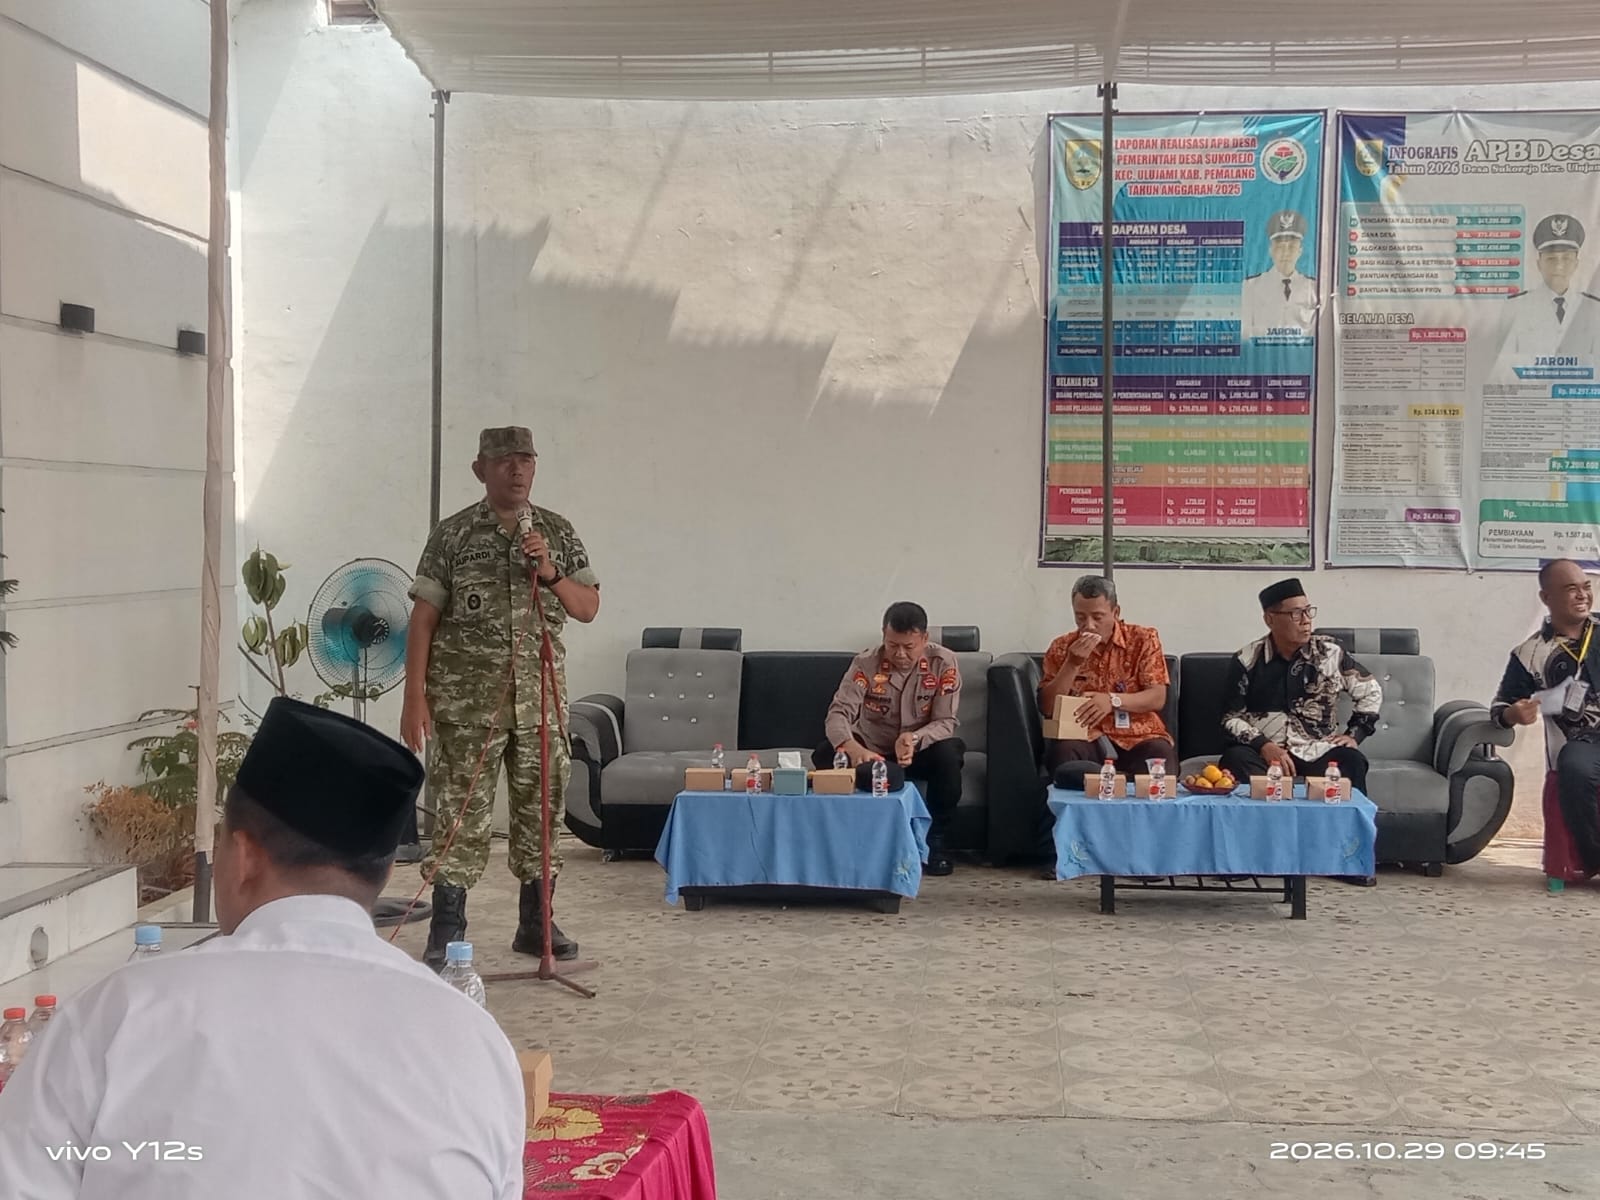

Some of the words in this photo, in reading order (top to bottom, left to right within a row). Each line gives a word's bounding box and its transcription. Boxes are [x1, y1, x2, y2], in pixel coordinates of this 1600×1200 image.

[1114, 138, 1158, 150] LAPORAN
[1160, 138, 1209, 150] REALISASI
[1210, 137, 1230, 149] APB
[1232, 137, 1257, 149] DESA
[1389, 146, 1458, 160] INFOGRAFIS
[1464, 139, 1600, 162] APBDesa
[1116, 153, 1177, 166] PEMERINTAH
[1178, 153, 1203, 165] DESA
[1205, 152, 1254, 165] SUKOREJO
[1114, 169, 1136, 181] KEC.
[1137, 169, 1178, 180] ULUJAMI
[1180, 168, 1203, 180] KAB.
[1204, 168, 1256, 180] PEMALANG
[1386, 161, 1425, 175] Tahun
[1427, 161, 1460, 175] 2026
[1128, 184, 1160, 196] TAHUN
[1161, 184, 1213, 196] ANGGARAN
[1215, 183, 1241, 195] 2025
[1091, 224, 1158, 235] PEDAPATAN
[1160, 224, 1188, 235] DESA
[1339, 313, 1386, 324] BELANJA
[1387, 313, 1415, 324] DESA
[1534, 356, 1578, 366] JARONI
[1503, 509, 1517, 519] Rp.
